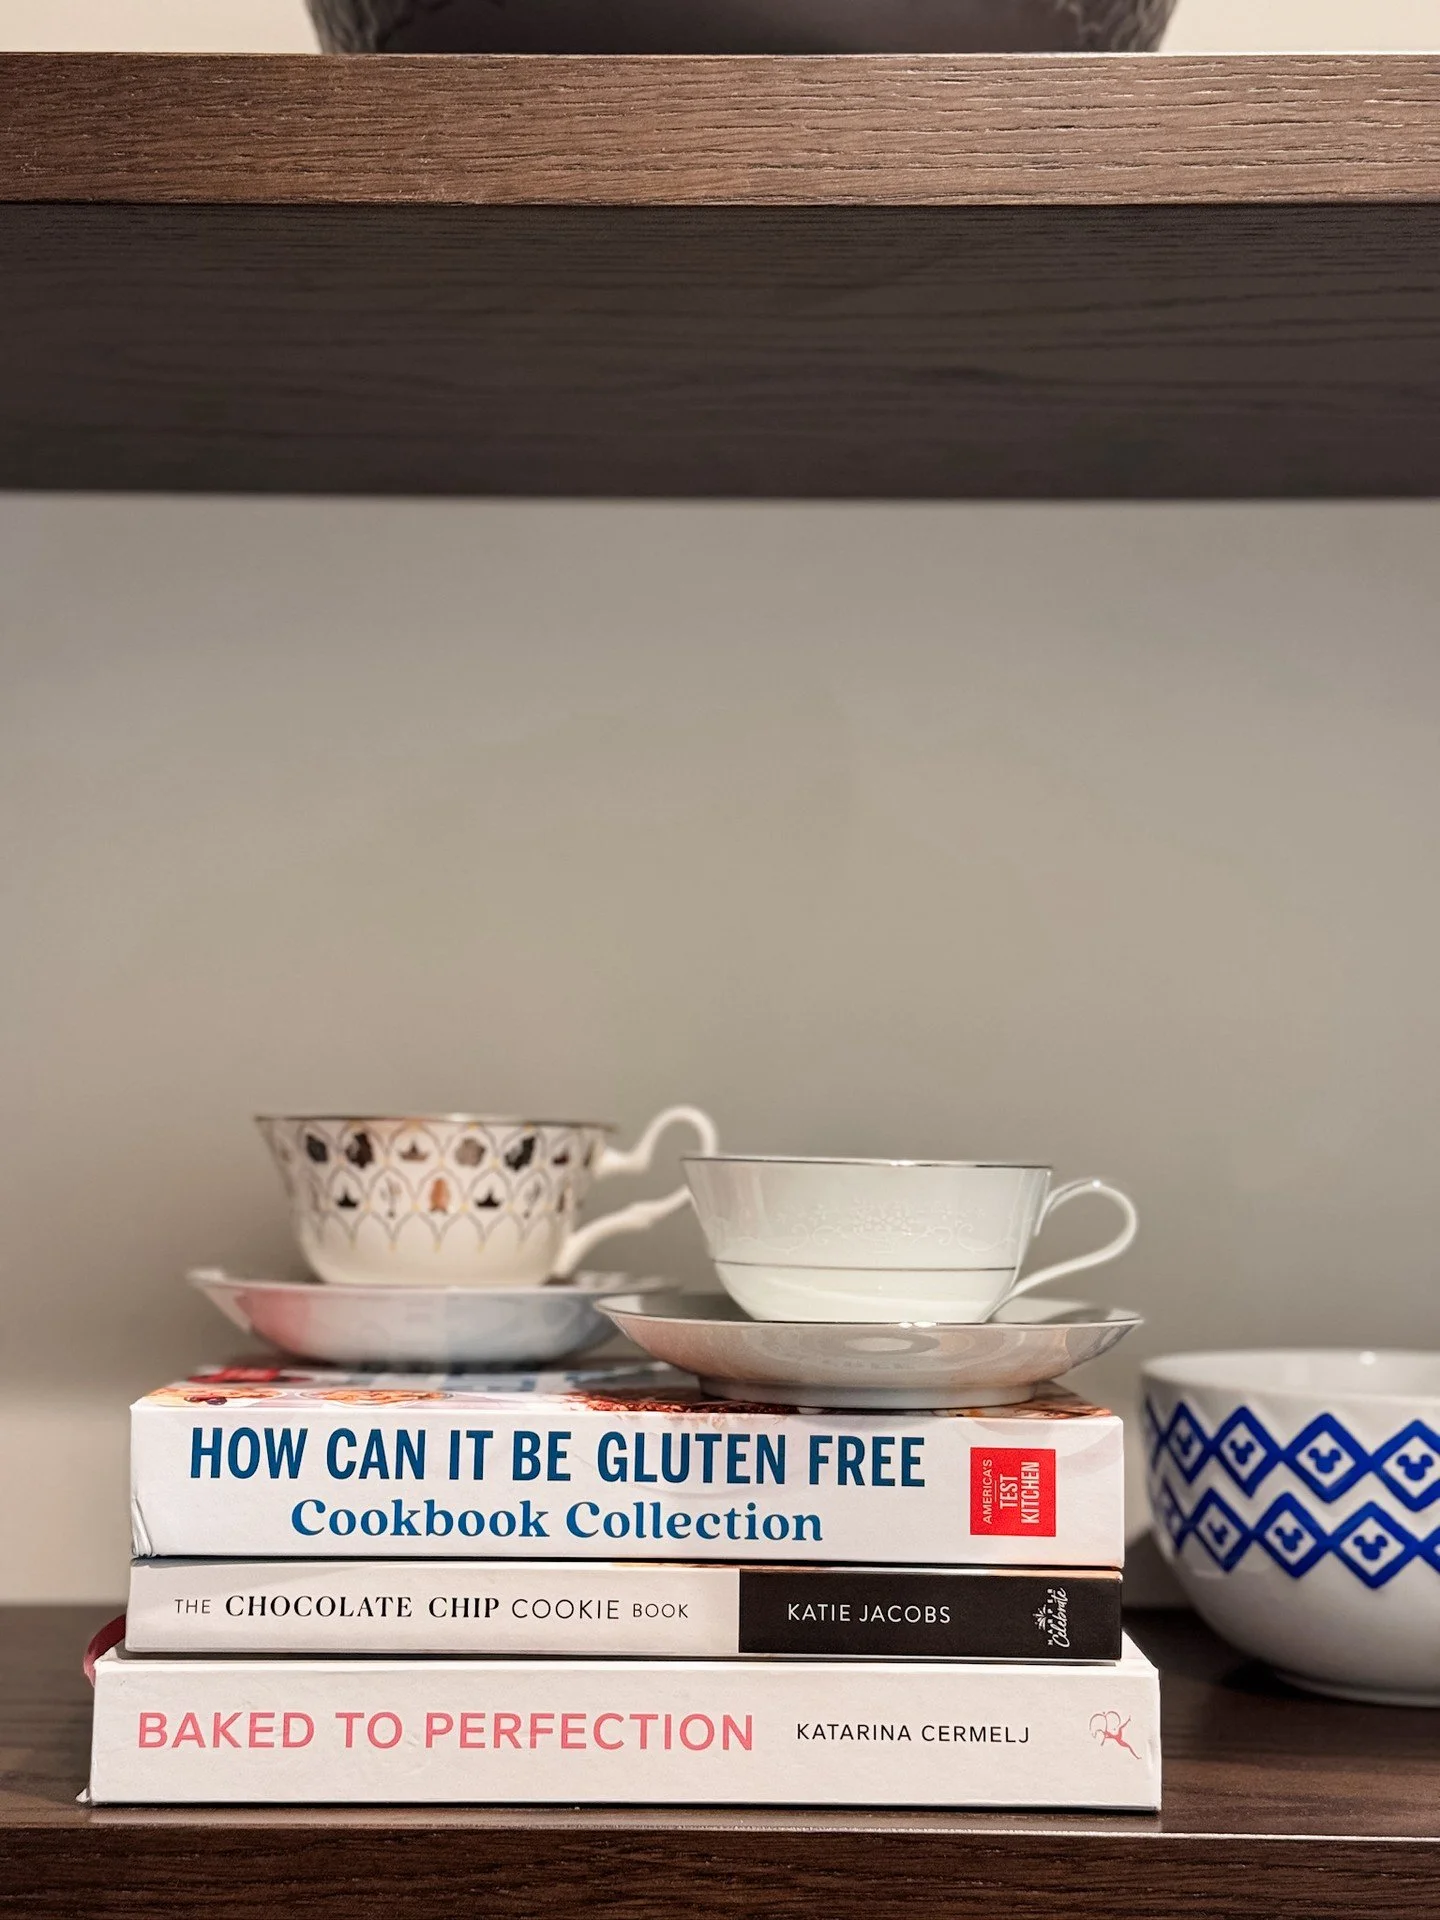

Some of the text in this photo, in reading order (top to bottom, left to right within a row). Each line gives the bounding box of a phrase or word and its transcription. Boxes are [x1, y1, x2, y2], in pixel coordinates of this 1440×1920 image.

[190, 1427, 926, 1488] HOW CAN IT BE GLUTEN FREE
[982, 1459, 993, 1524] AMERICA'S
[1000, 1474, 1018, 1509] TEST
[1021, 1461, 1039, 1524] KITCHEN
[291, 1499, 823, 1541] Cookbook Collection
[174, 1595, 688, 1620] THE CHOCOLATE CHIP COOKIE BOOK
[788, 1603, 951, 1624] KATIE JACOBS
[1050, 1587, 1070, 1648] Celebrate
[137, 1712, 753, 1752] BAKED TO PERFECTION
[797, 1723, 1029, 1744] KATARINA CERMELJ
